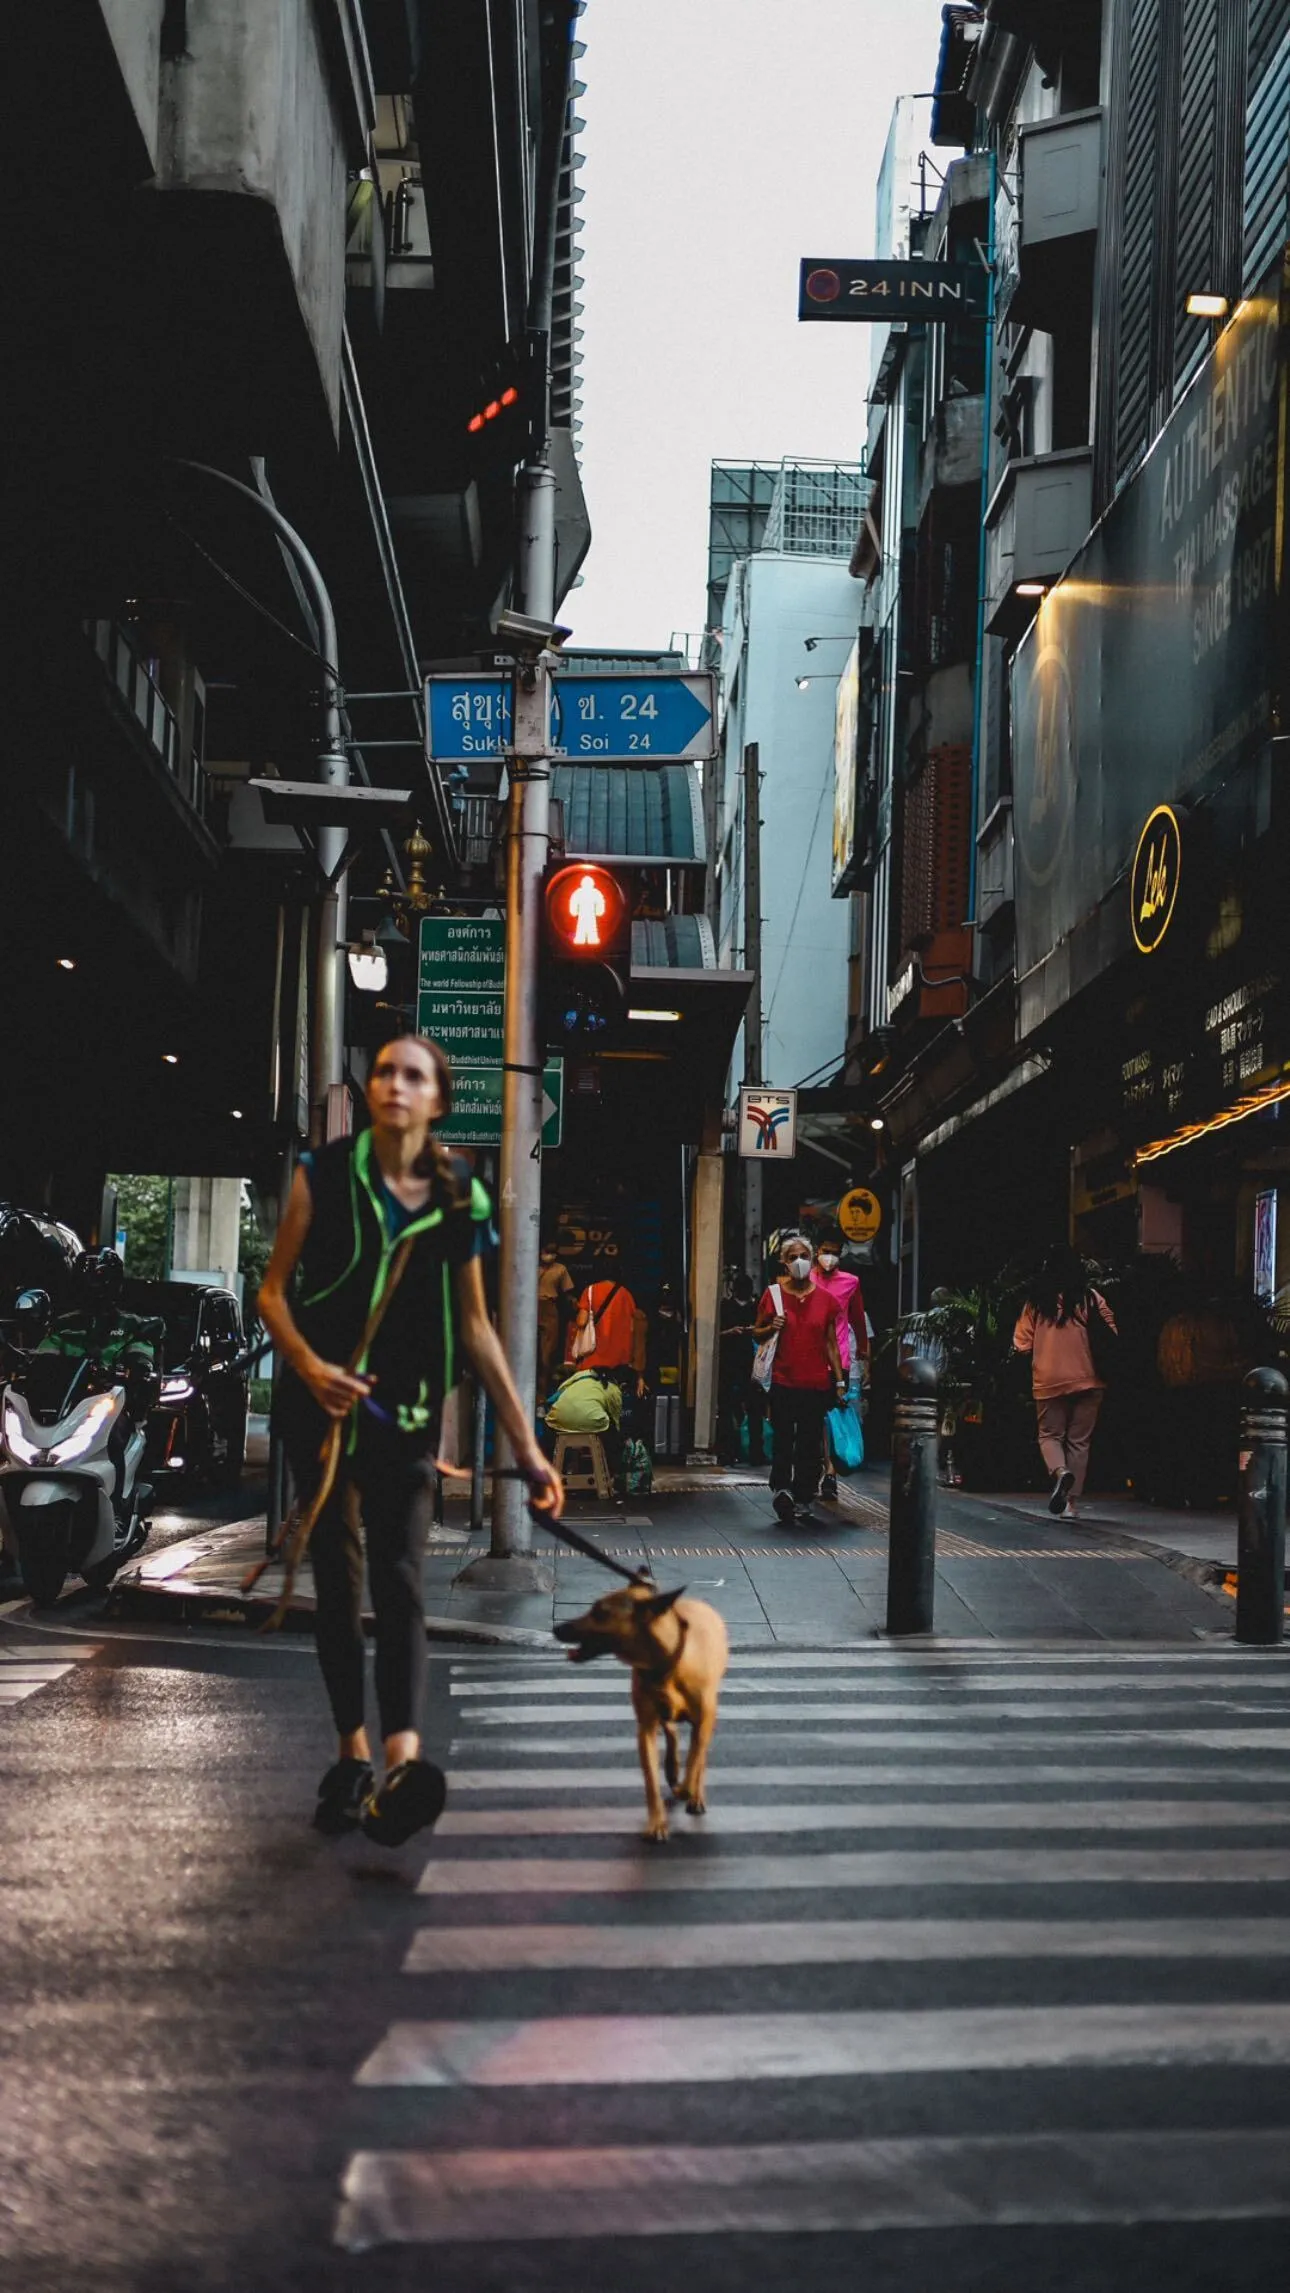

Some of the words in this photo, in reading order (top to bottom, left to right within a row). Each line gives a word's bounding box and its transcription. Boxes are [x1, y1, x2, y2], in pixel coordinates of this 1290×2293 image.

[849, 279, 890, 297] 24
[899, 280, 961, 299] INN
[1160, 305, 1279, 541] AUTHENTIC
[1173, 522, 1201, 604] THAI
[1203, 431, 1275, 568] MASSAGE
[1193, 569, 1232, 666] SINCE
[1236, 526, 1273, 614] 1997
[619, 693, 659, 721] 24
[579, 733, 610, 751] Soi
[628, 733, 652, 751] 24
[431, 999, 502, 1016] มหาวิทยาลัย
[747, 1094, 790, 1105] BTS
